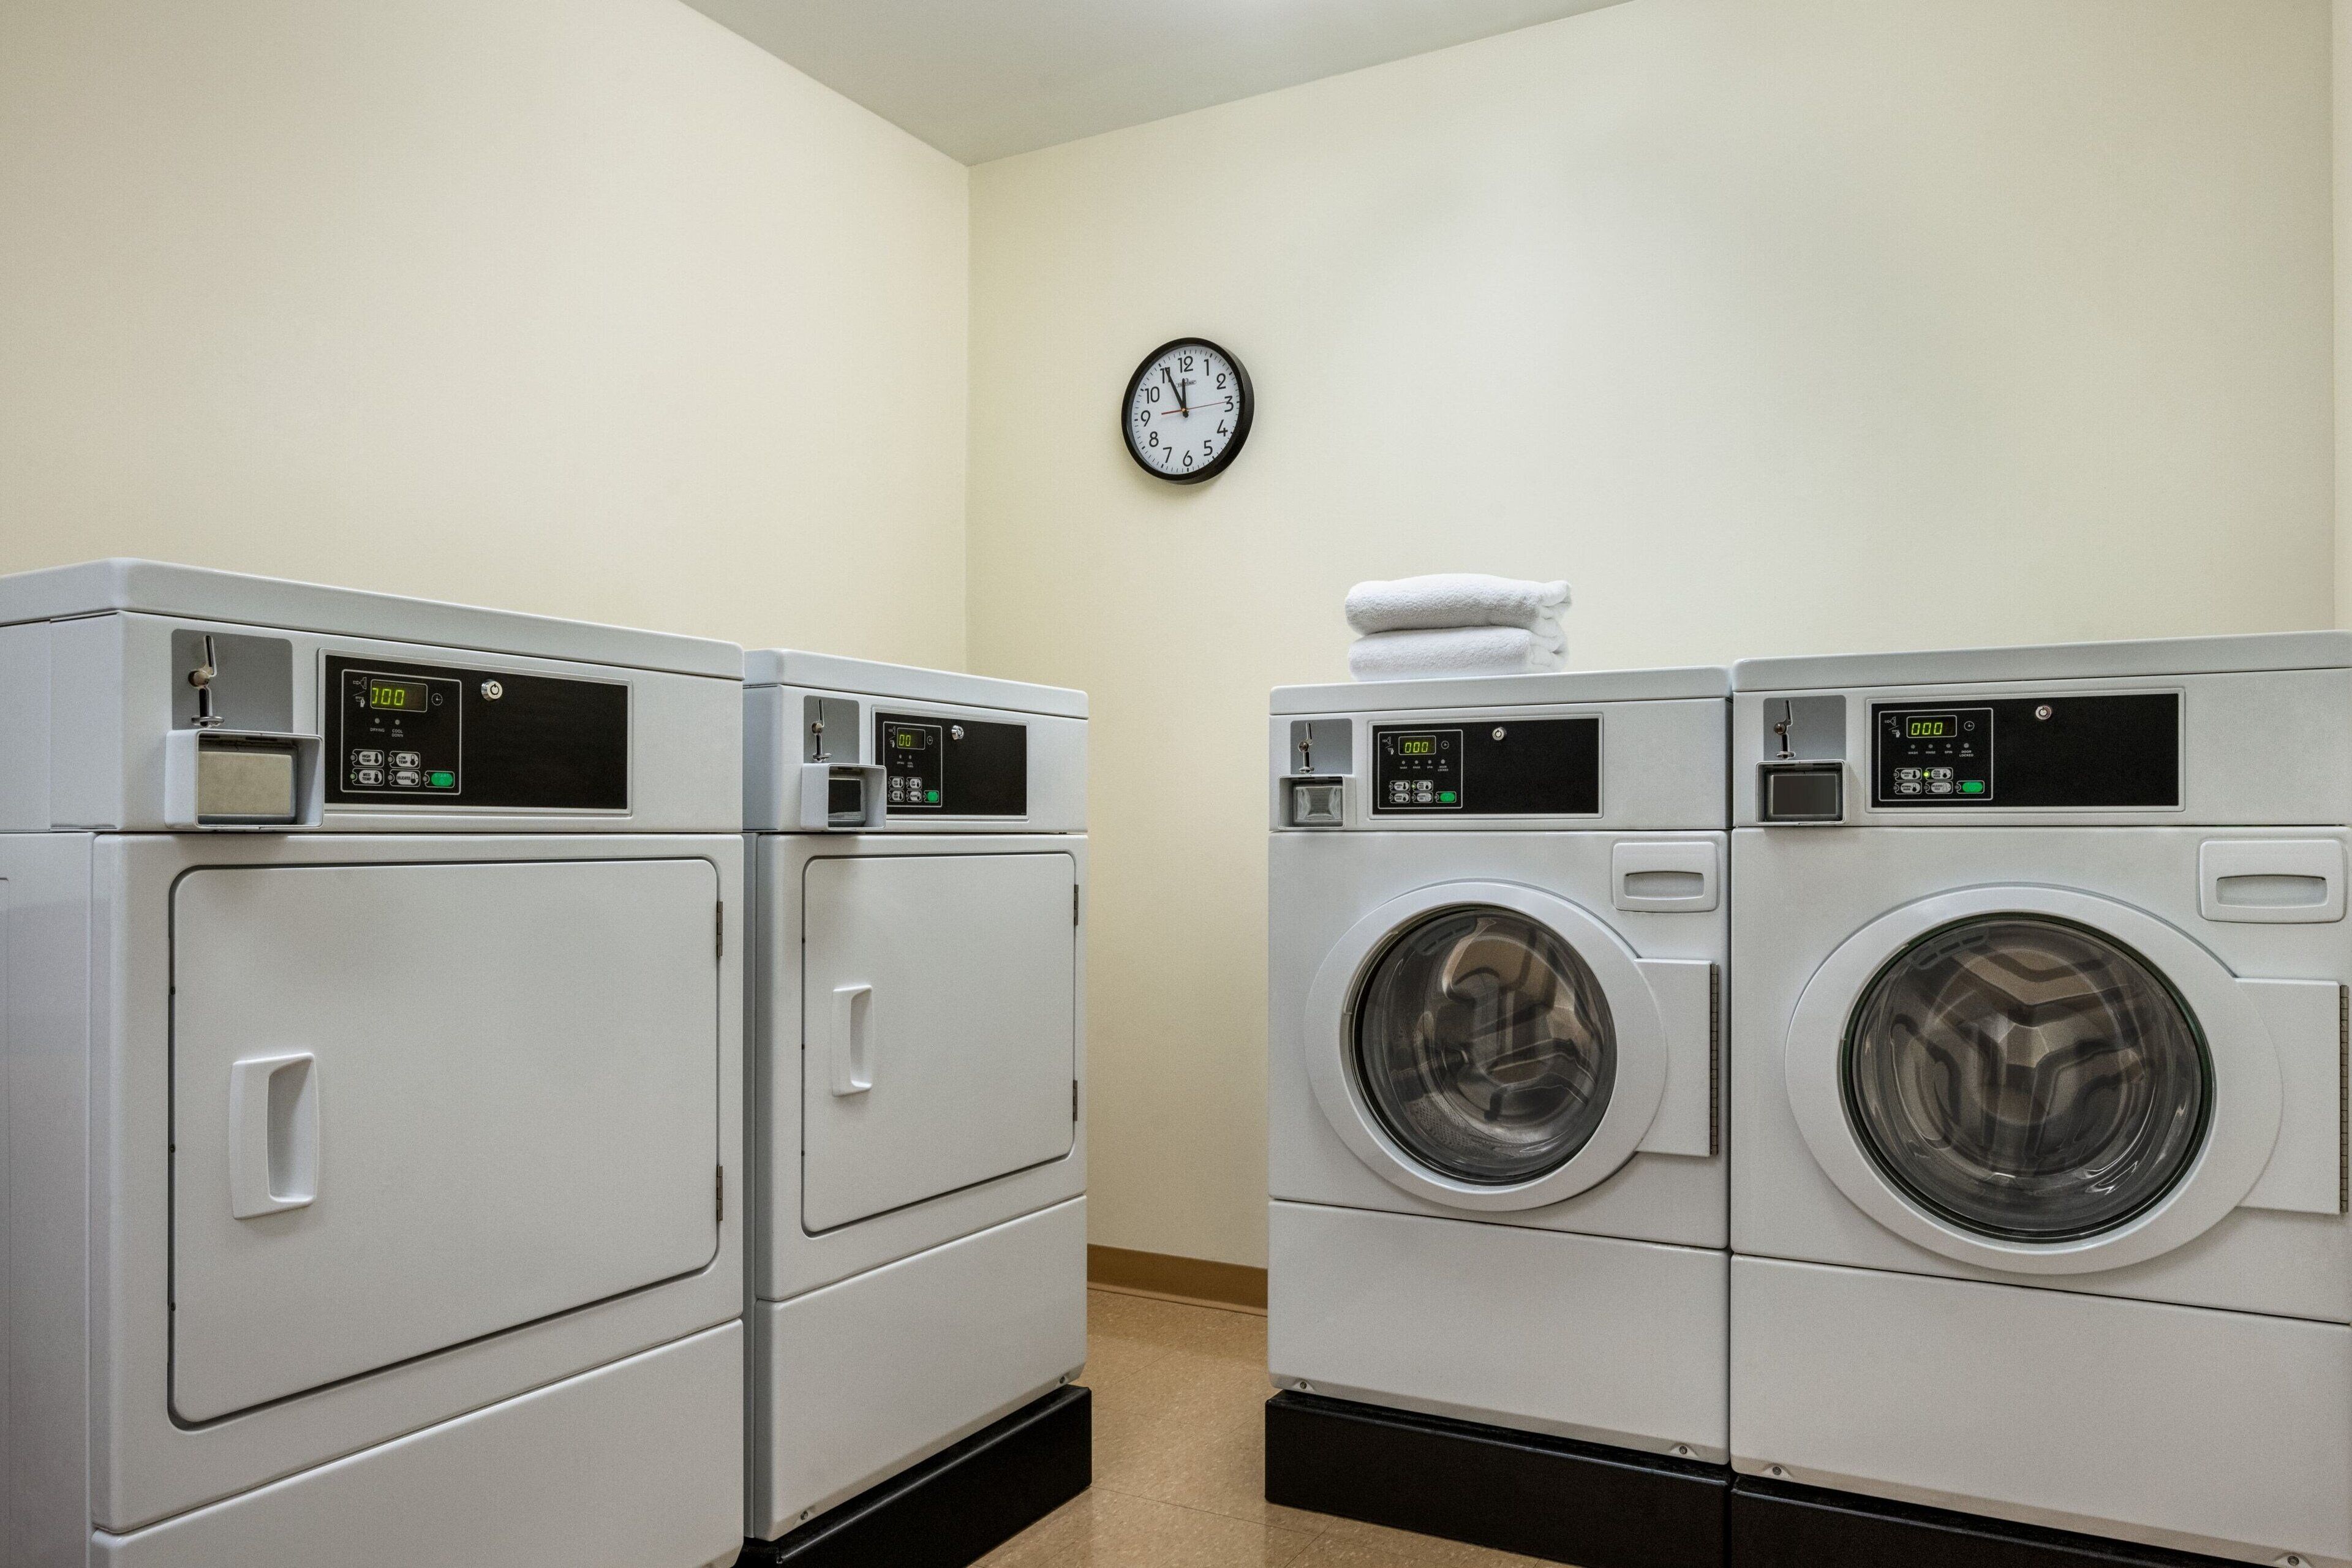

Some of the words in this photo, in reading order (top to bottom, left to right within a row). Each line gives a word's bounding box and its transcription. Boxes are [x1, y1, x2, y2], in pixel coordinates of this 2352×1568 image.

[1178, 356, 1194, 373] 12
[1204, 359, 1210, 376] 1
[1216, 373, 1226, 390] 2
[1145, 386, 1160, 404] 10
[1225, 395, 1234, 413] 3
[1140, 410, 1151, 427] 9
[1217, 420, 1228, 437] 4
[1149, 431, 1159, 448] 8
[1204, 440, 1213, 456] 5
[1163, 447, 1172, 463] 7
[1183, 450, 1193, 467] 6
[1911, 722, 1943, 735] 000
[1405, 742, 1429, 753] 000
